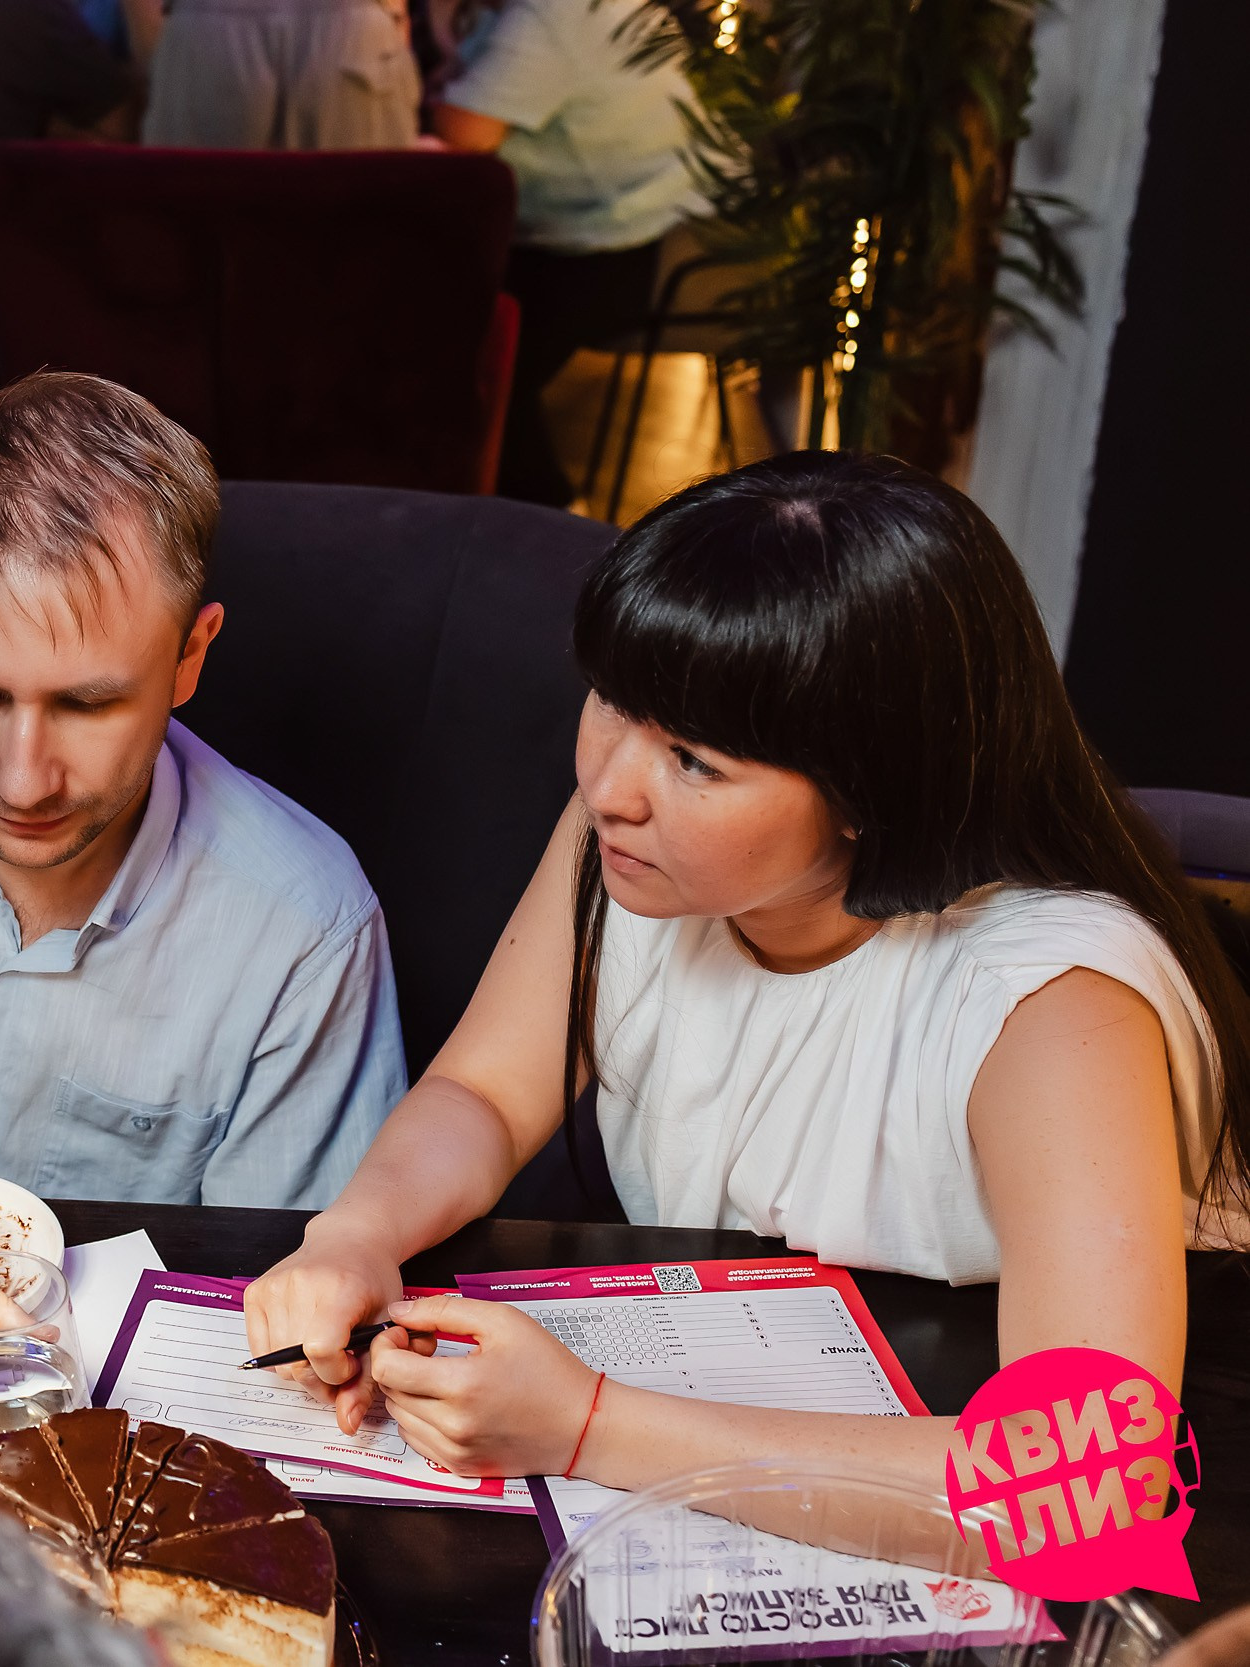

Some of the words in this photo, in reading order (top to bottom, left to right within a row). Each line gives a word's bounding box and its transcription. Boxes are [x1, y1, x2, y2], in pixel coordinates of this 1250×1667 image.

[154, 1284, 232, 1298] PVL.QUIZPLEASE.COM
[490, 1280, 570, 1289] PVL.QUIZPLEASE.COM
[323, 1446, 362, 1454] КОМАНДЫ
[364, 1451, 402, 1464] НАЗВАНИЕ
[720, 1606, 868, 1632] ПРОСТО
